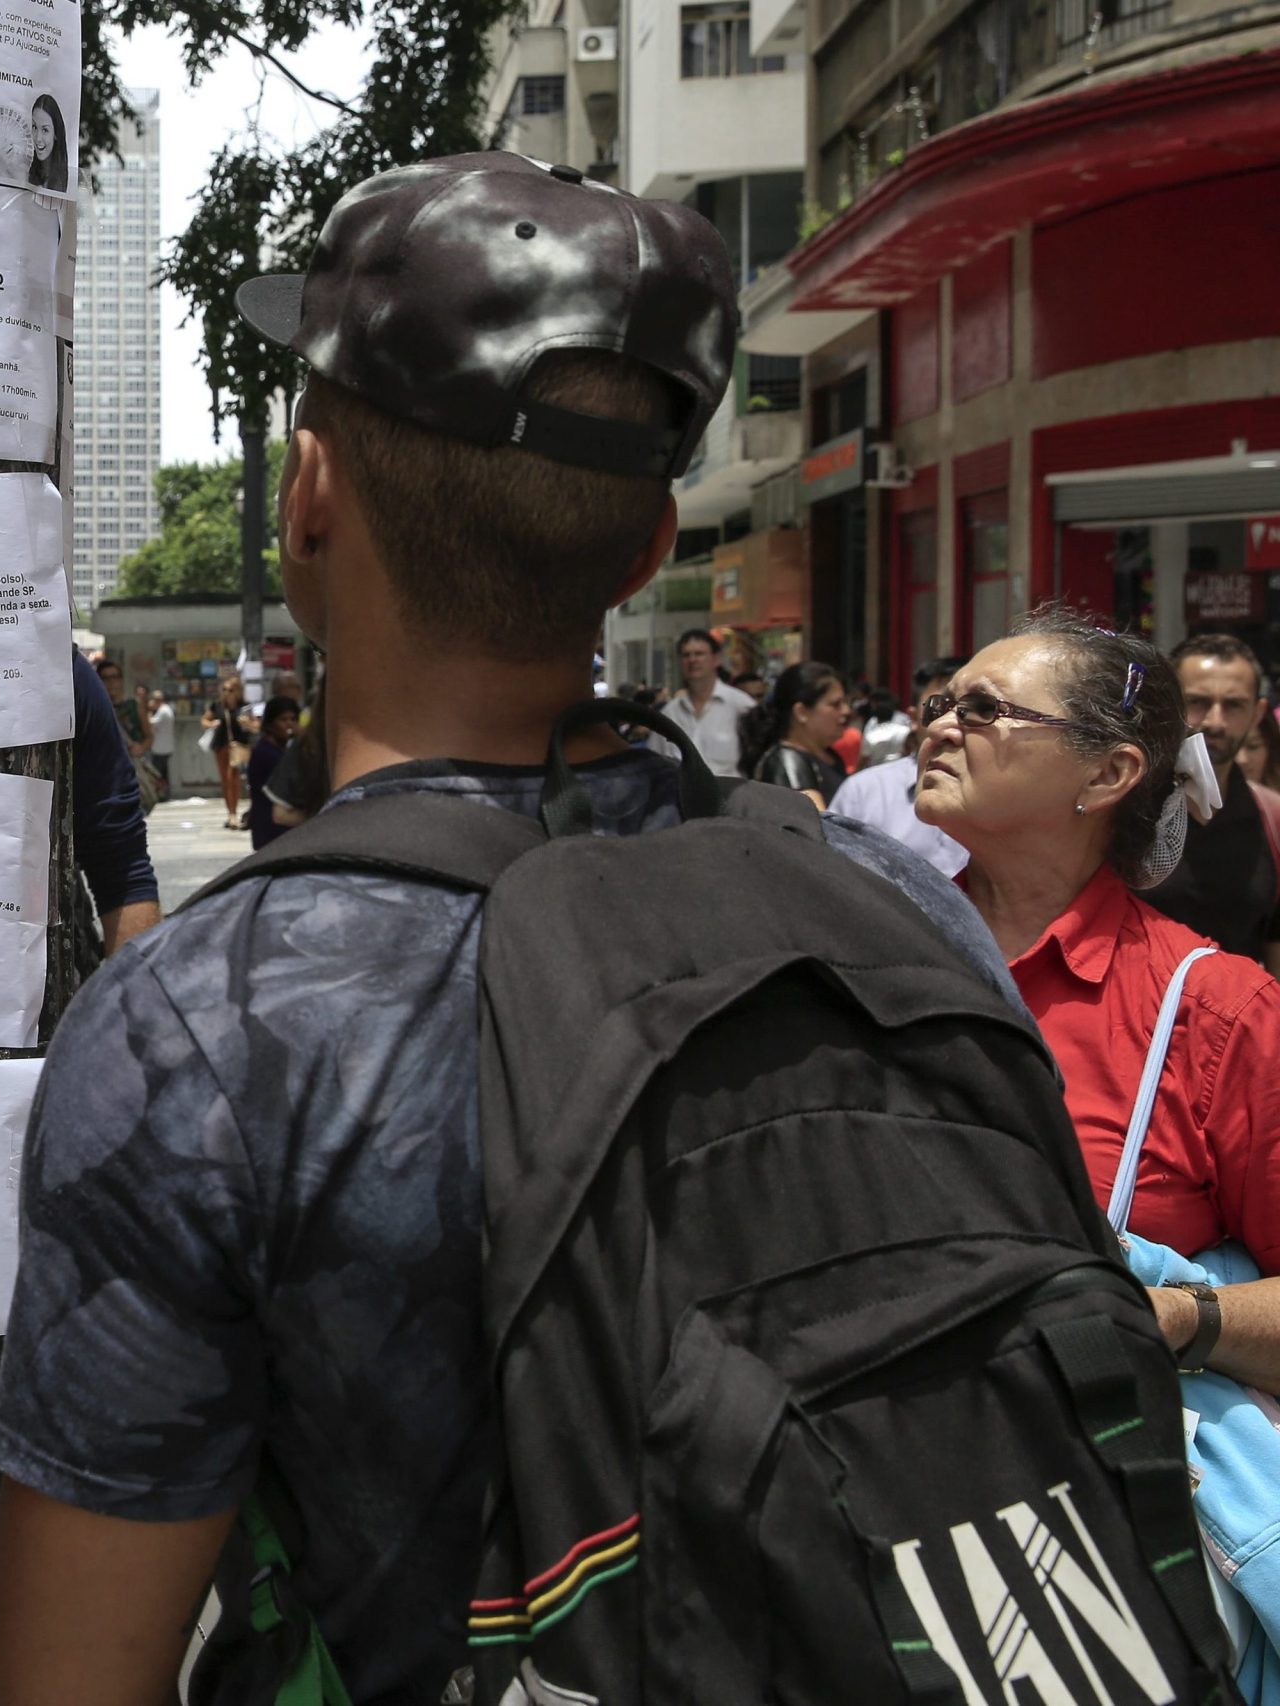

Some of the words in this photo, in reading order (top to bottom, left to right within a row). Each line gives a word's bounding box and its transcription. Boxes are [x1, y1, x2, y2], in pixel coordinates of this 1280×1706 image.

[16, 27, 45, 43] ATIVOS
[16, 39, 50, 56] Ajuizados
[5, 316, 32, 330] duvidas
[2, 385, 38, 399] 17h00min.
[28, 599, 52, 609] sexta.
[3, 668, 23, 680] 209.
